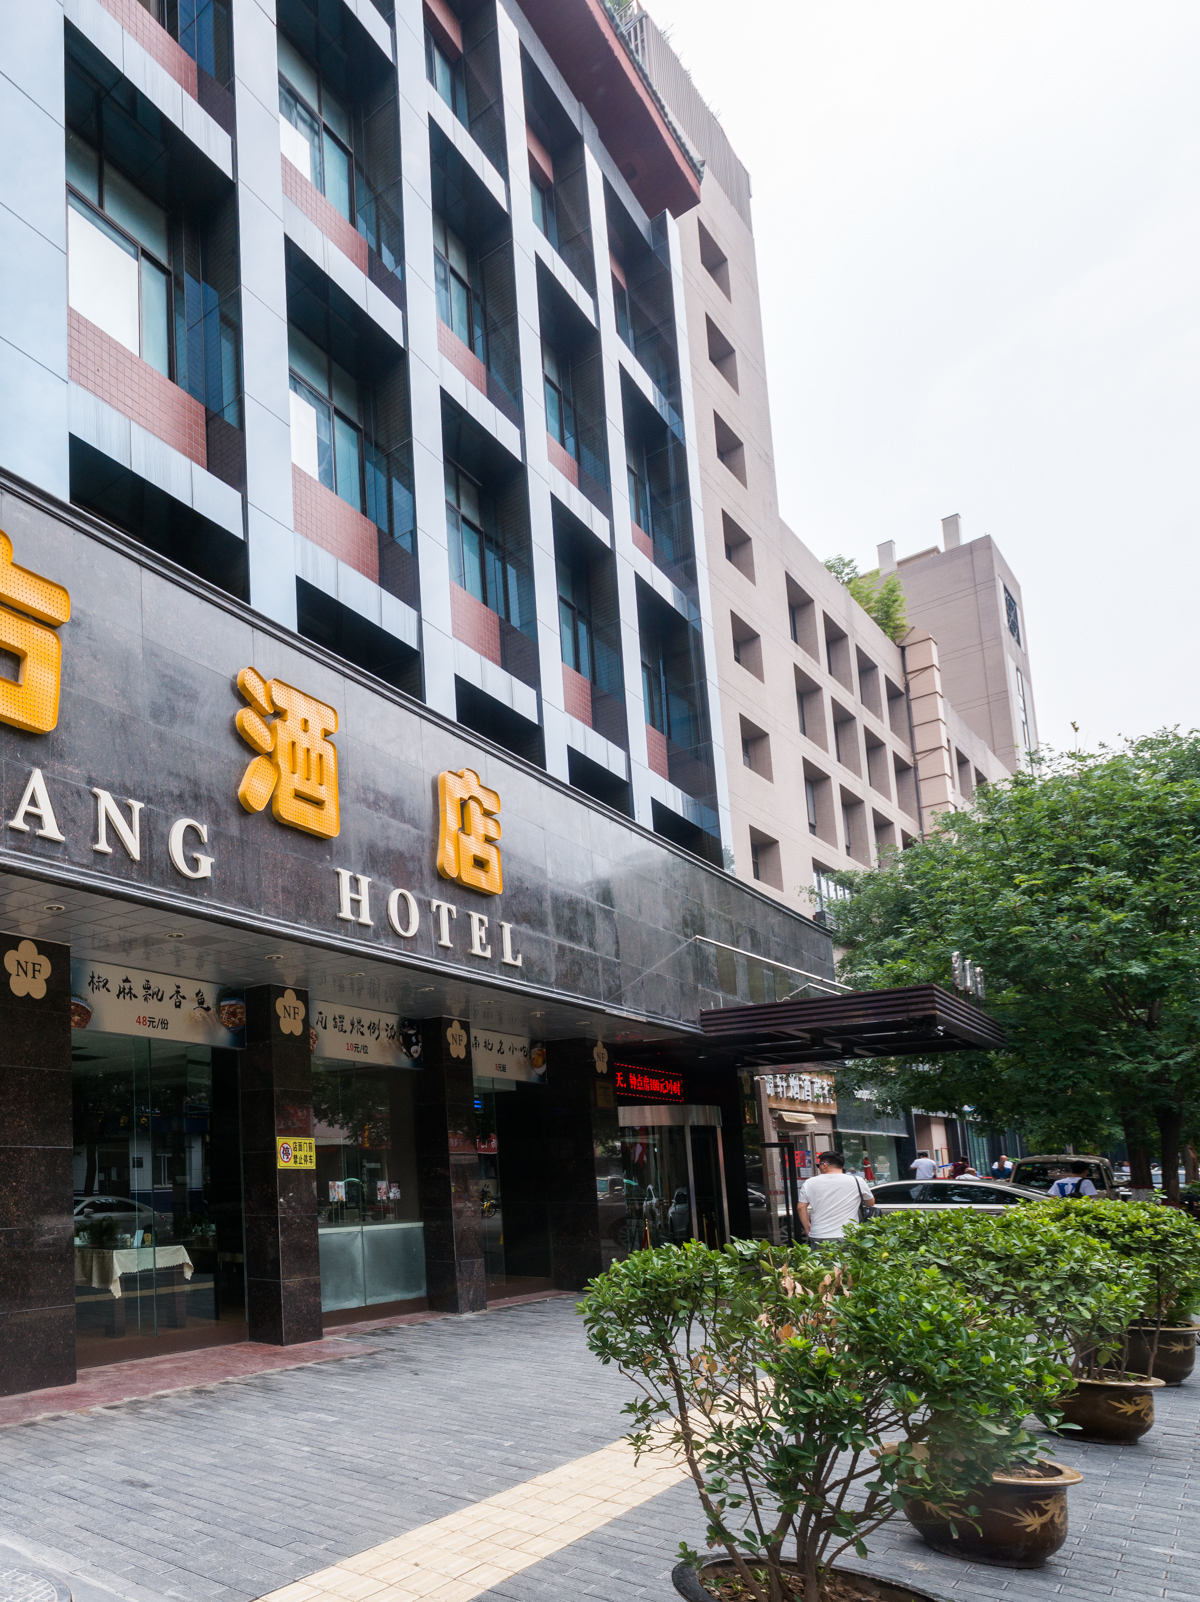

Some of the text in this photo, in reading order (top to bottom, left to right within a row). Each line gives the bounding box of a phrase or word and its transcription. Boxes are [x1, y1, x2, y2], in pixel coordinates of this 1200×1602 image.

[335, 867, 523, 967] HOTEL
[15, 959, 43, 980] NF
[88, 970, 212, 1013] 椒麻飘香鱼
[282, 1004, 300, 1021] NF
[136, 1015, 169, 1031] 48元/份
[451, 1033, 464, 1046] NF
[471, 1035, 529, 1058] 南北名小吃
[346, 1042, 369, 1055] 10元/位
[596, 1051, 606, 1063] NF
[293, 1141, 313, 1153] 店面门前
[293, 1154, 313, 1165] 禁止停车
